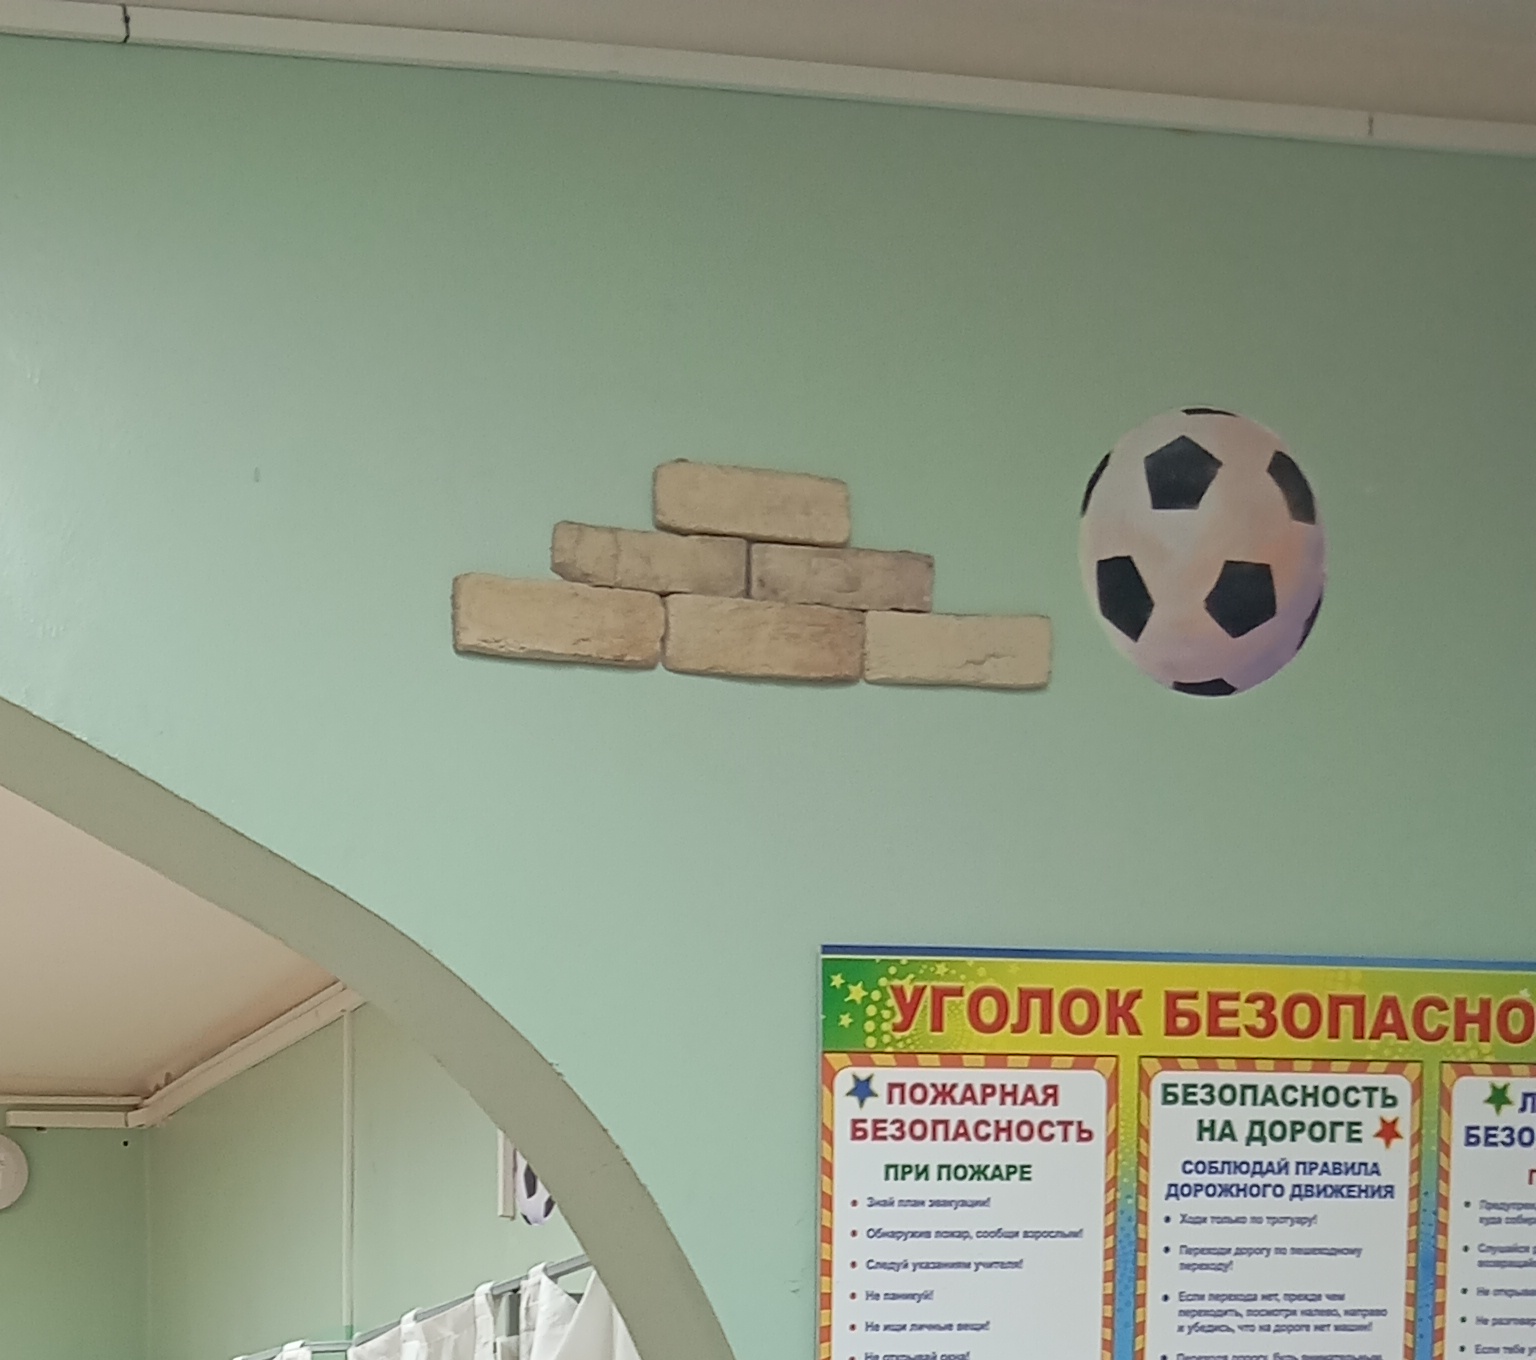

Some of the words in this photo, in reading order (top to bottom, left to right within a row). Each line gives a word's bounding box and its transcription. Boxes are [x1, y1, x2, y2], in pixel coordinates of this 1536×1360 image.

[890, 983, 1143, 1037] УГОЛОК
[1164, 988, 1536, 1044] БЕЗОПАСНО
[886, 1082, 1059, 1106] ПОЖАРНАЯ
[1161, 1083, 1399, 1109] БЕЗОПАСНОСТЬ
[850, 1118, 1094, 1143] БЕЗОПАСНОСТЬ
[1197, 1119, 1237, 1142] НА
[1245, 1120, 1363, 1146] ДОРОГЕ
[883, 1164, 929, 1181] ПРИ
[936, 1164, 1032, 1181] ПОЖАРЕ
[1182, 1158, 1289, 1178] СОБЛЮДАЙ
[1295, 1161, 1381, 1176] ПРАВИЛА
[1165, 1183, 1284, 1201] ДОРОЖНОГО
[1289, 1184, 1395, 1201] ДВИЖЕНИЯ
[865, 1291, 880, 1300] Не
[865, 1322, 880, 1332] Не
